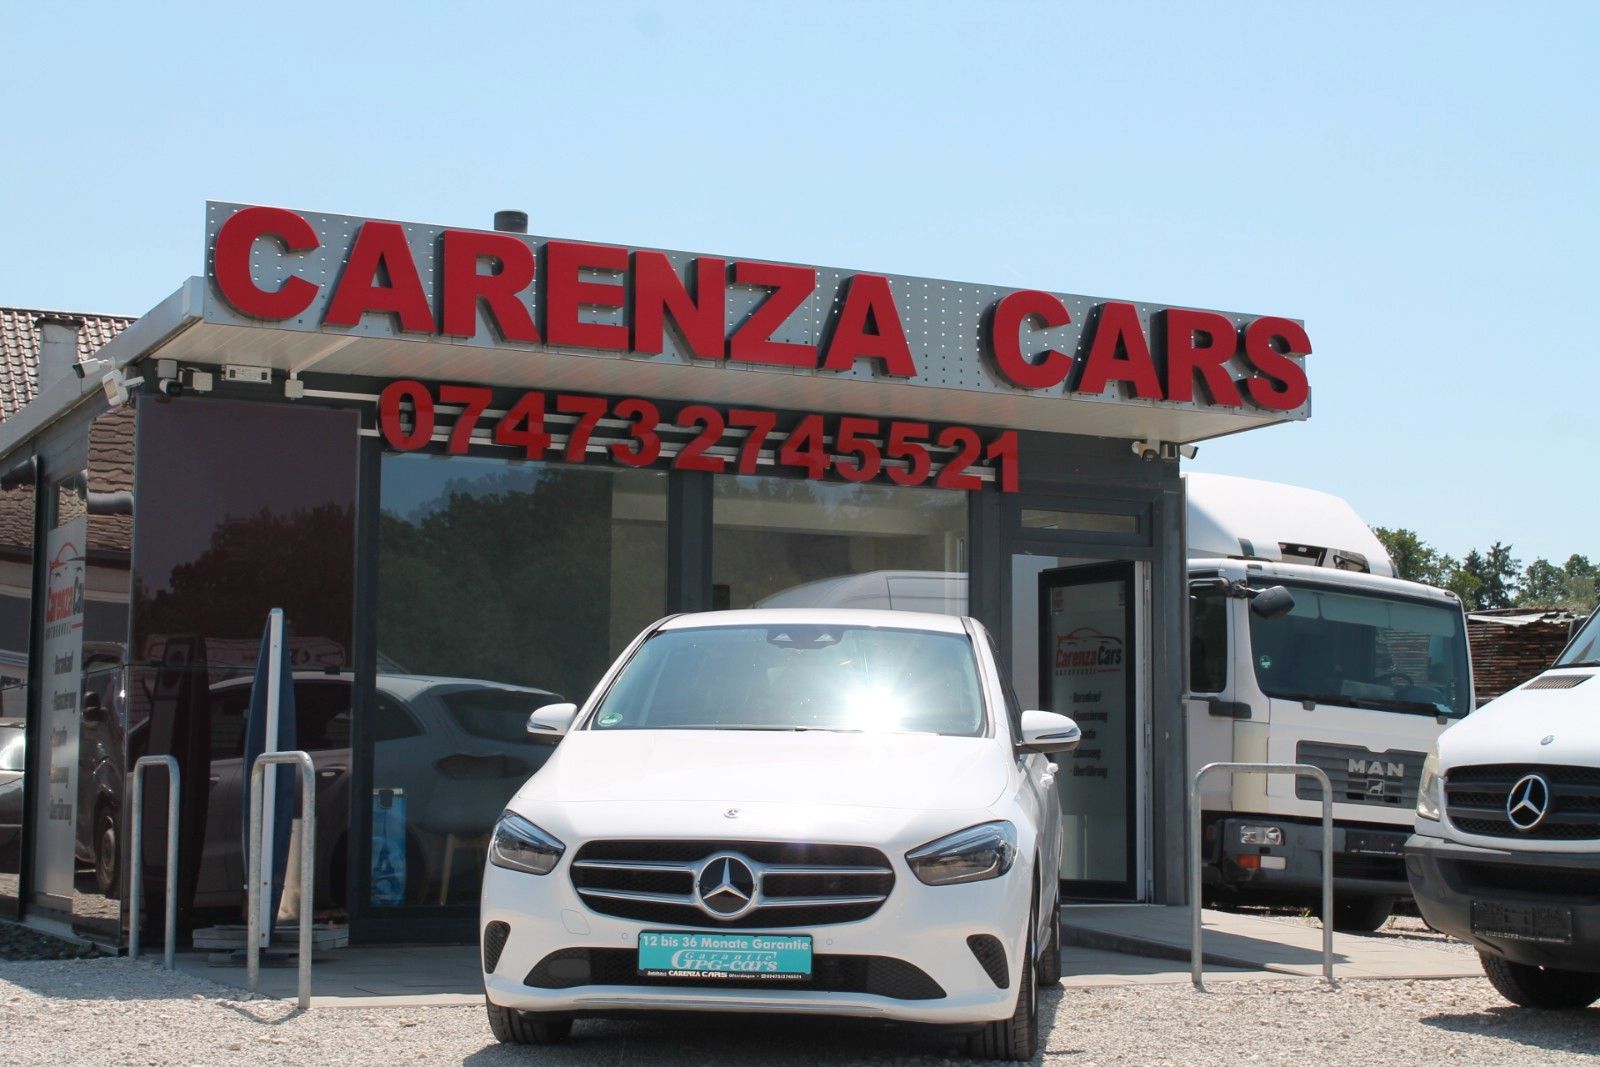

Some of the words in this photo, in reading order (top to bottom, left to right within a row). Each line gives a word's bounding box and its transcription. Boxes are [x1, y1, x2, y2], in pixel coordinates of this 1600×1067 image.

[213, 206, 917, 377] CARENZA
[991, 289, 1313, 411] CARS
[1098, 646, 1122, 666] Cars
[1348, 758, 1404, 777] MAN
[643, 935, 658, 947] 12
[661, 936, 679, 947] bis
[682, 936, 698, 948] 36
[701, 937, 748, 949] Monate
[752, 939, 809, 951] Garantie
